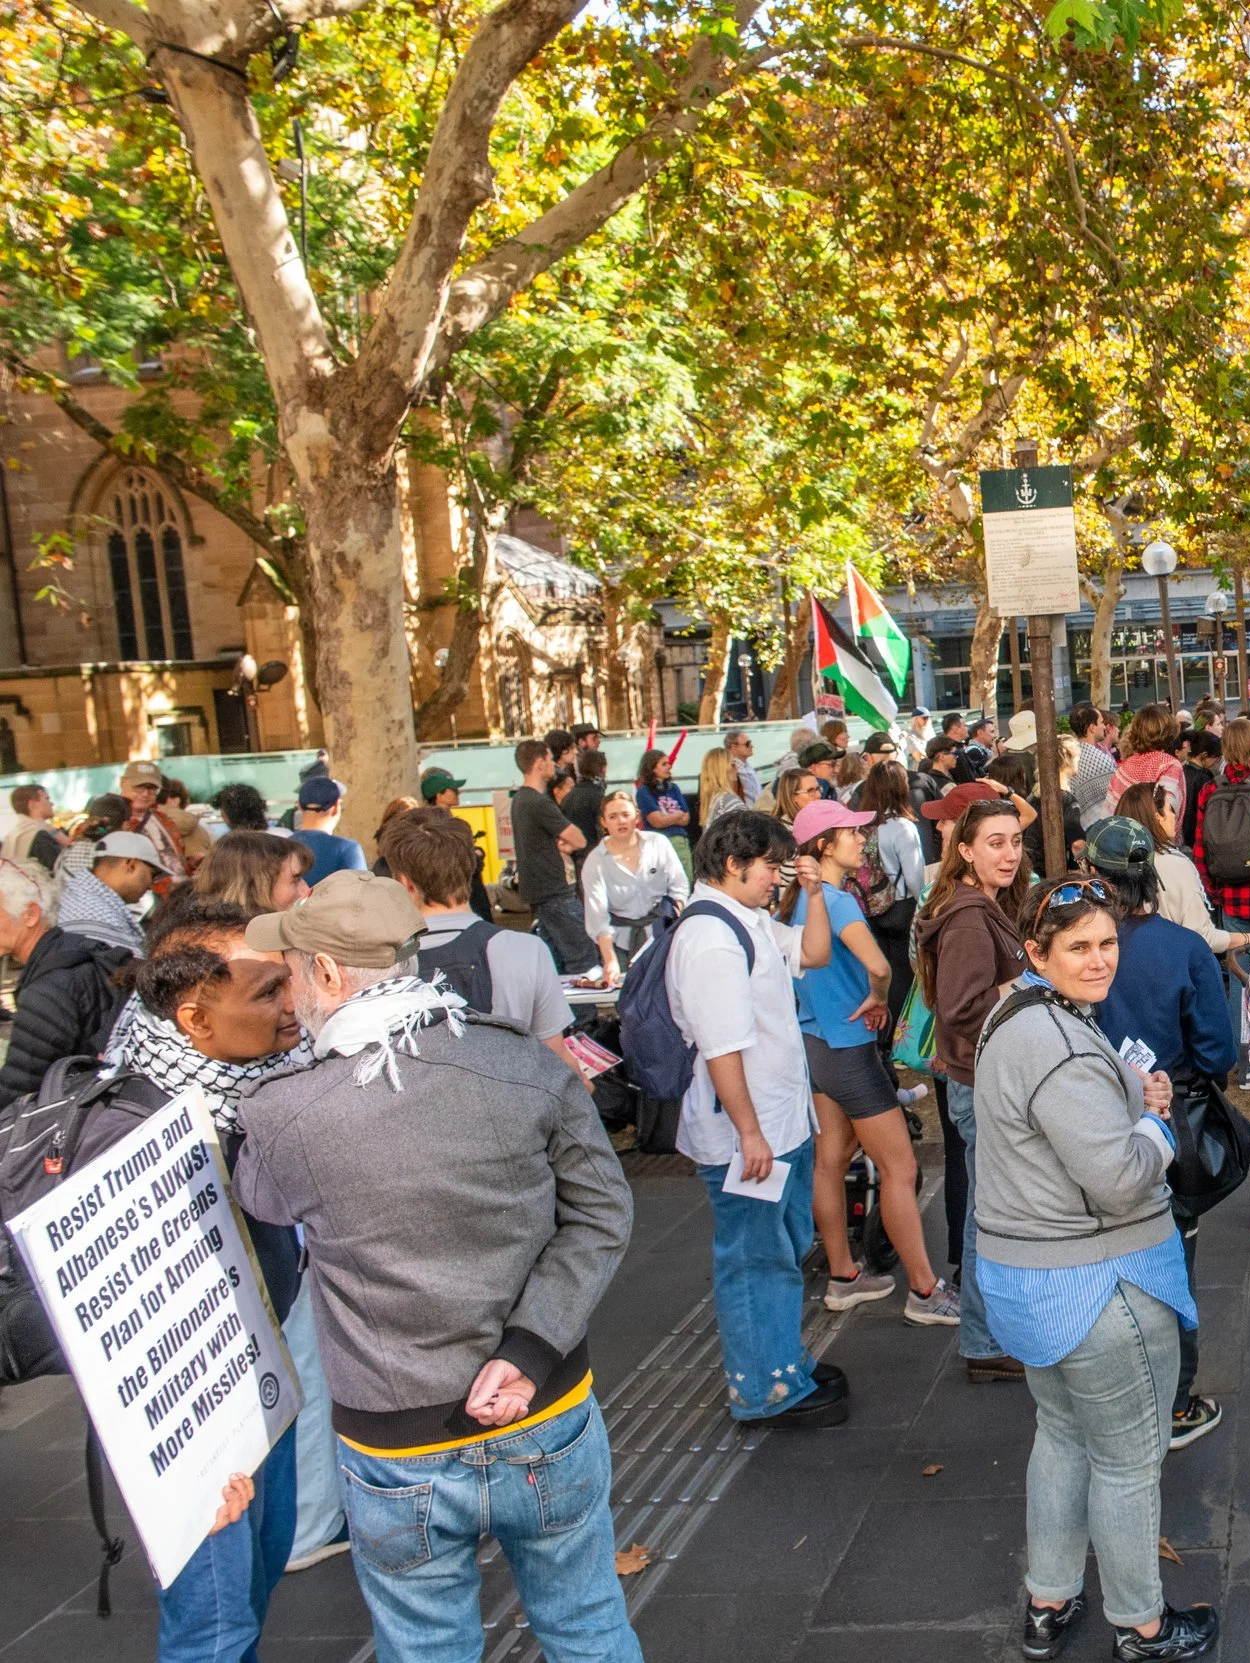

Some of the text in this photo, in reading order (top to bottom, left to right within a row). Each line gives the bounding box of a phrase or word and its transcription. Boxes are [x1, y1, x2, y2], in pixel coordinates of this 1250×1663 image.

[45, 1106, 193, 1252] Resist Trump and
[56, 1138, 209, 1298] Albanese's AUKUS!
[74, 1182, 218, 1332] Resist the Greens
[100, 1224, 223, 1361] Plan for Arming
[117, 1365, 148, 1407] the
[146, 1265, 240, 1375] Billionaire's
[144, 1312, 241, 1430] Military with
[149, 1417, 193, 1476] More
[191, 1332, 261, 1426] Missiles!
